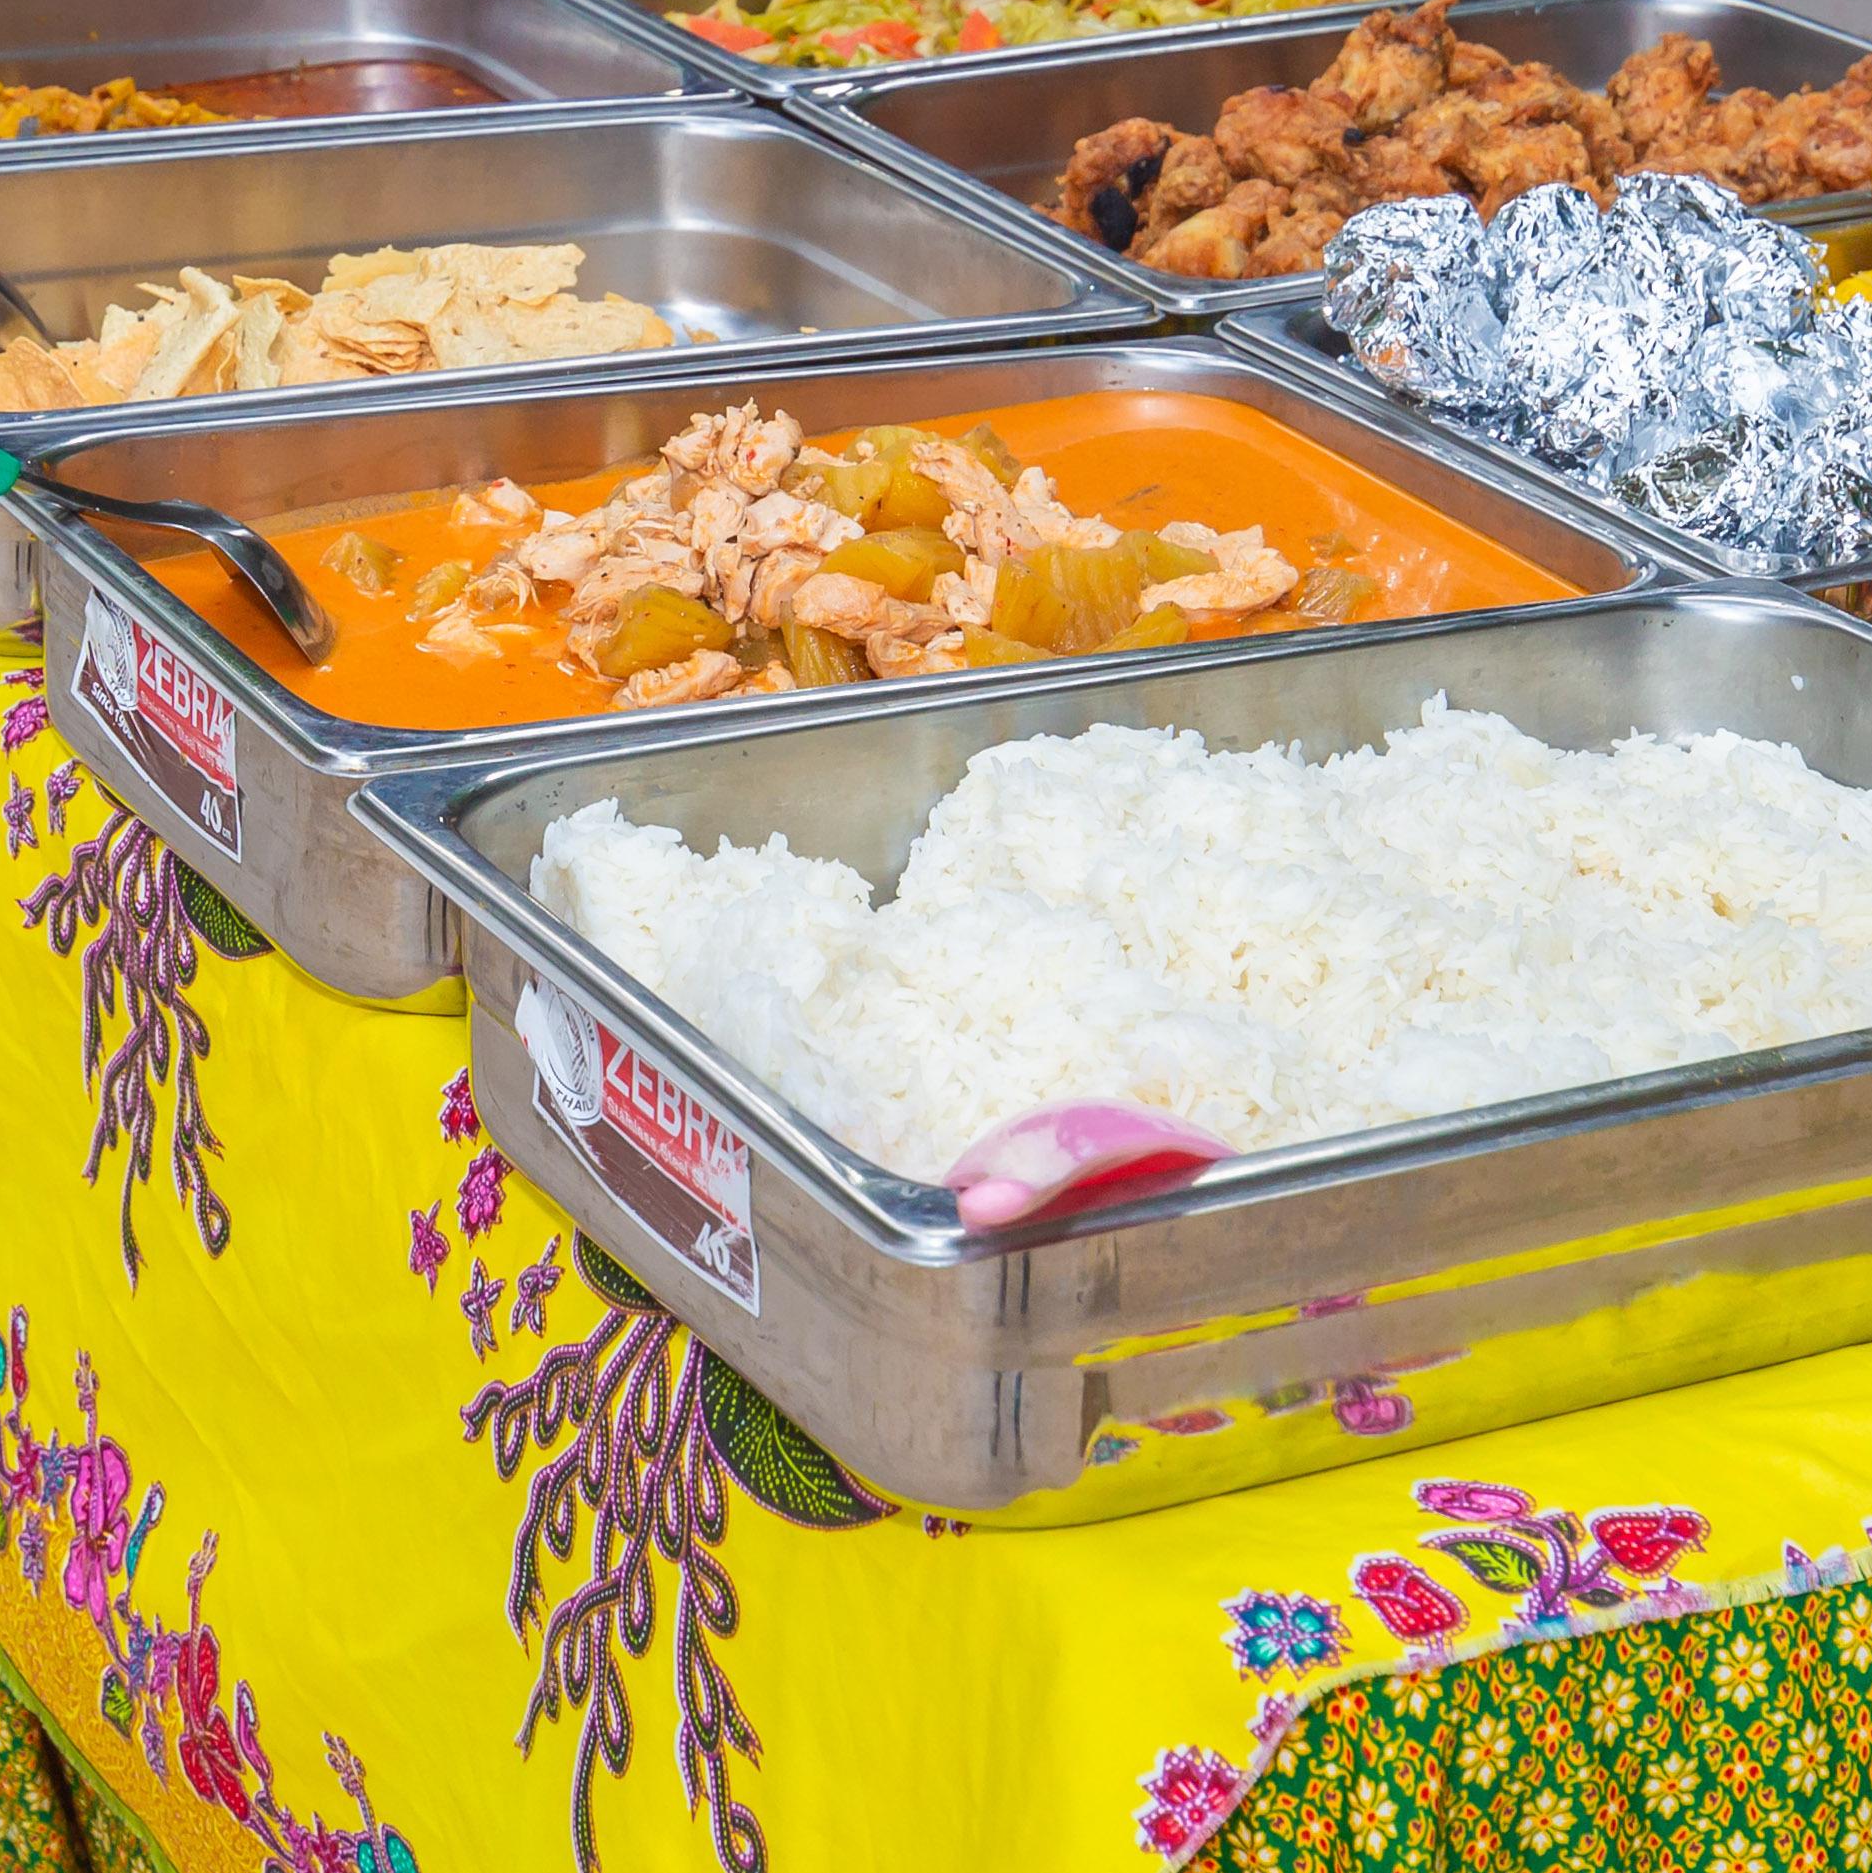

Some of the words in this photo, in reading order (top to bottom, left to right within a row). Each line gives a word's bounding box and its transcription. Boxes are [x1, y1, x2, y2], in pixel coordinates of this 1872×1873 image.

[139, 631, 231, 741] ZEBRA
[200, 789, 222, 834] 40
[555, 1085, 596, 1113] THAIL
[606, 1041, 739, 1173] ZEBRA
